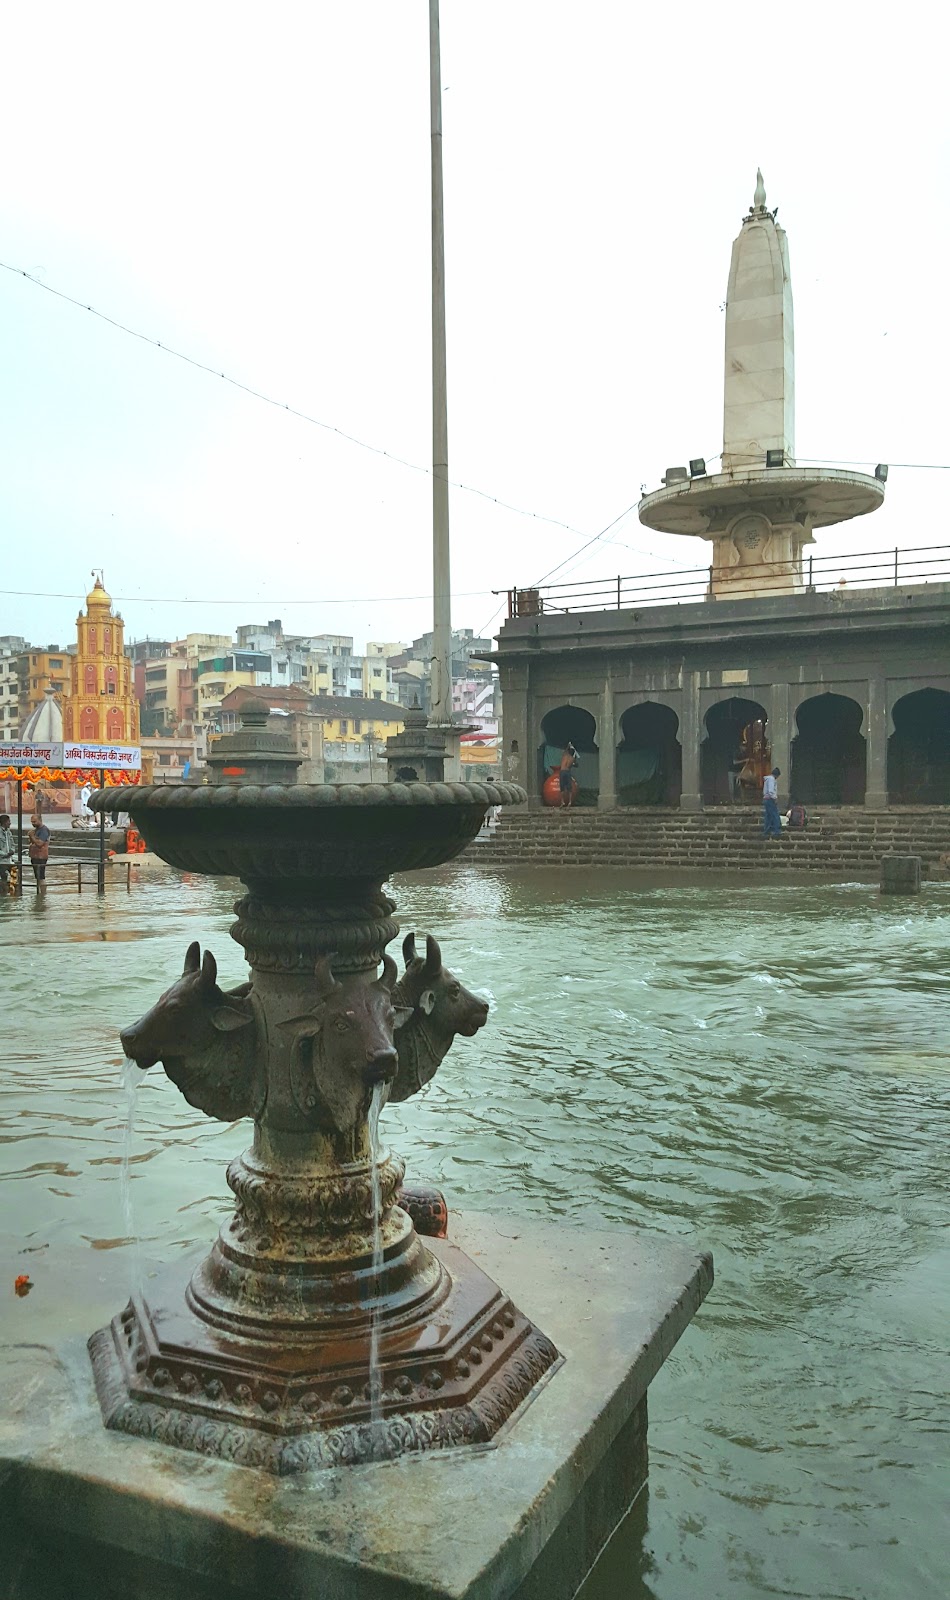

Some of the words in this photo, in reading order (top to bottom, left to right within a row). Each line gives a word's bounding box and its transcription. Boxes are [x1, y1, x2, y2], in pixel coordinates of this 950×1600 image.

[22, 746, 32, 758] की
[33, 749, 51, 760] जगह
[83, 748, 107, 761] विसर्जन
[108, 750, 117, 760] की
[118, 753, 132, 763] जगह
